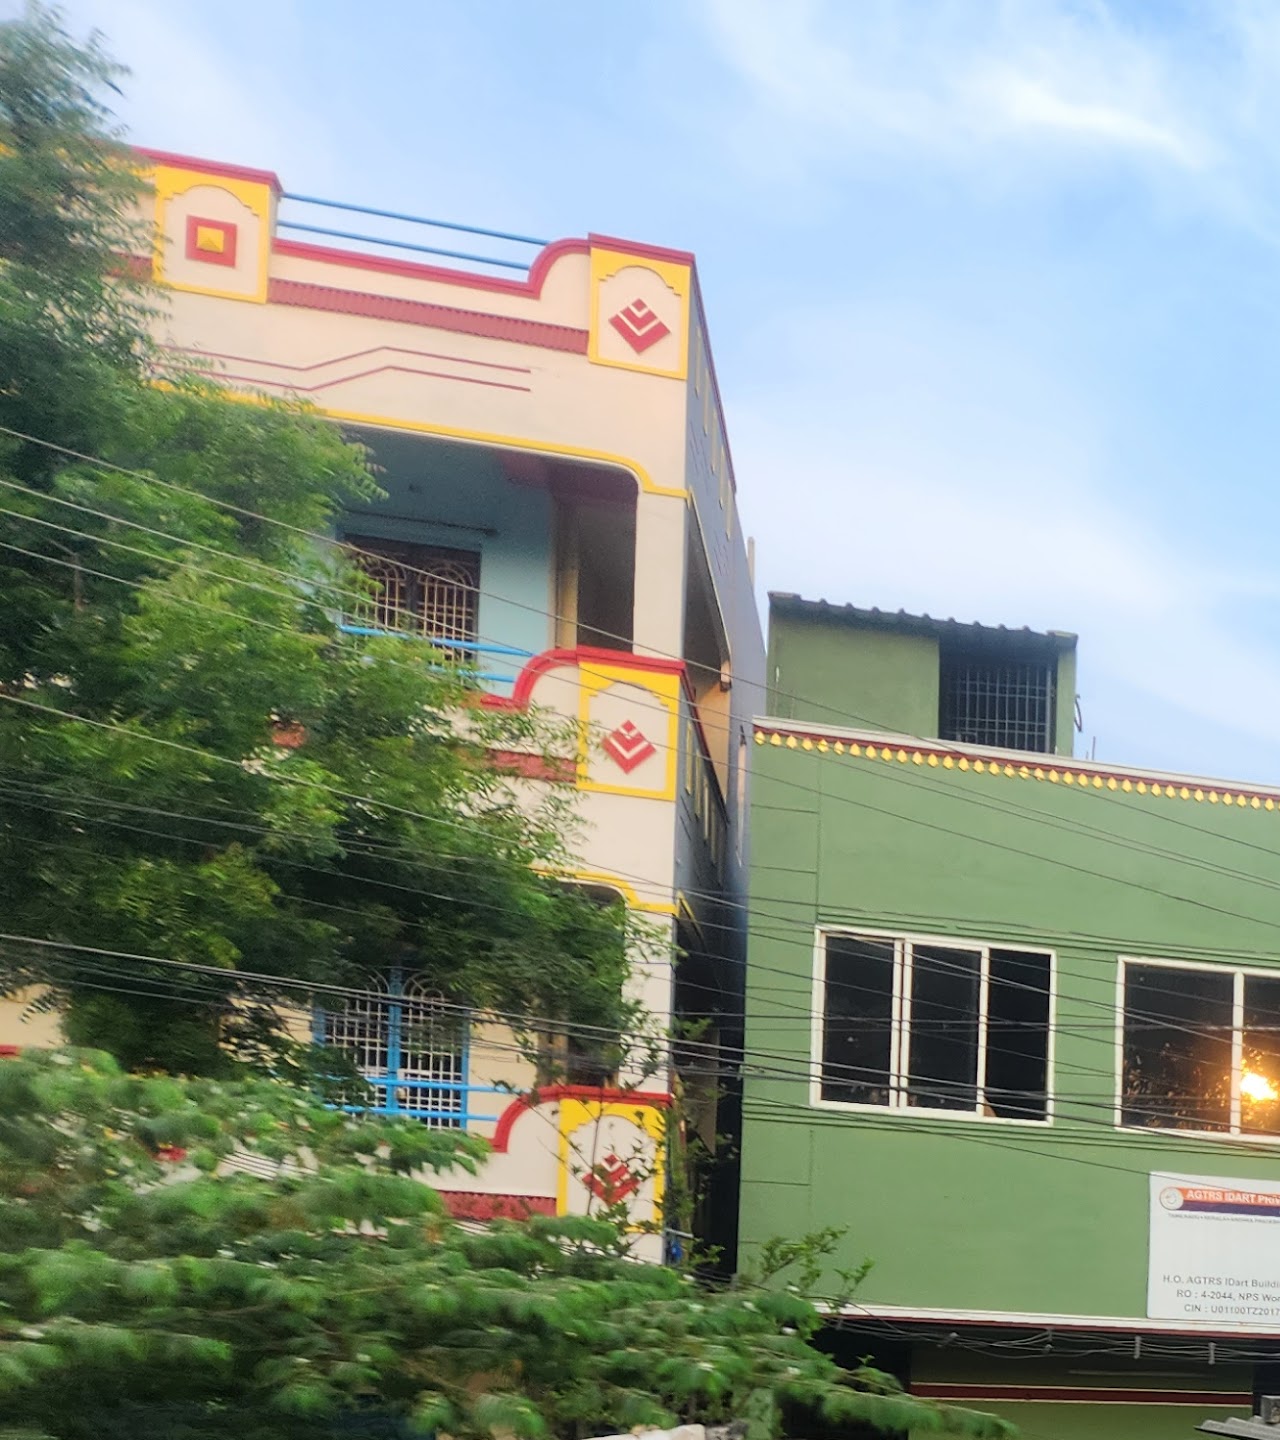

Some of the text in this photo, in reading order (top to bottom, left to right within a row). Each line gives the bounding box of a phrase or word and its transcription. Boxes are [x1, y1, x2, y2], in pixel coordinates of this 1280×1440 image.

[1185, 1189, 1223, 1202] AGTRS
[1224, 1190, 1256, 1204] IDART
[1187, 1276, 1223, 1286] AGTRS
[1238, 1292, 1259, 1301] NPS
[1183, 1303, 1202, 1313] CIN
